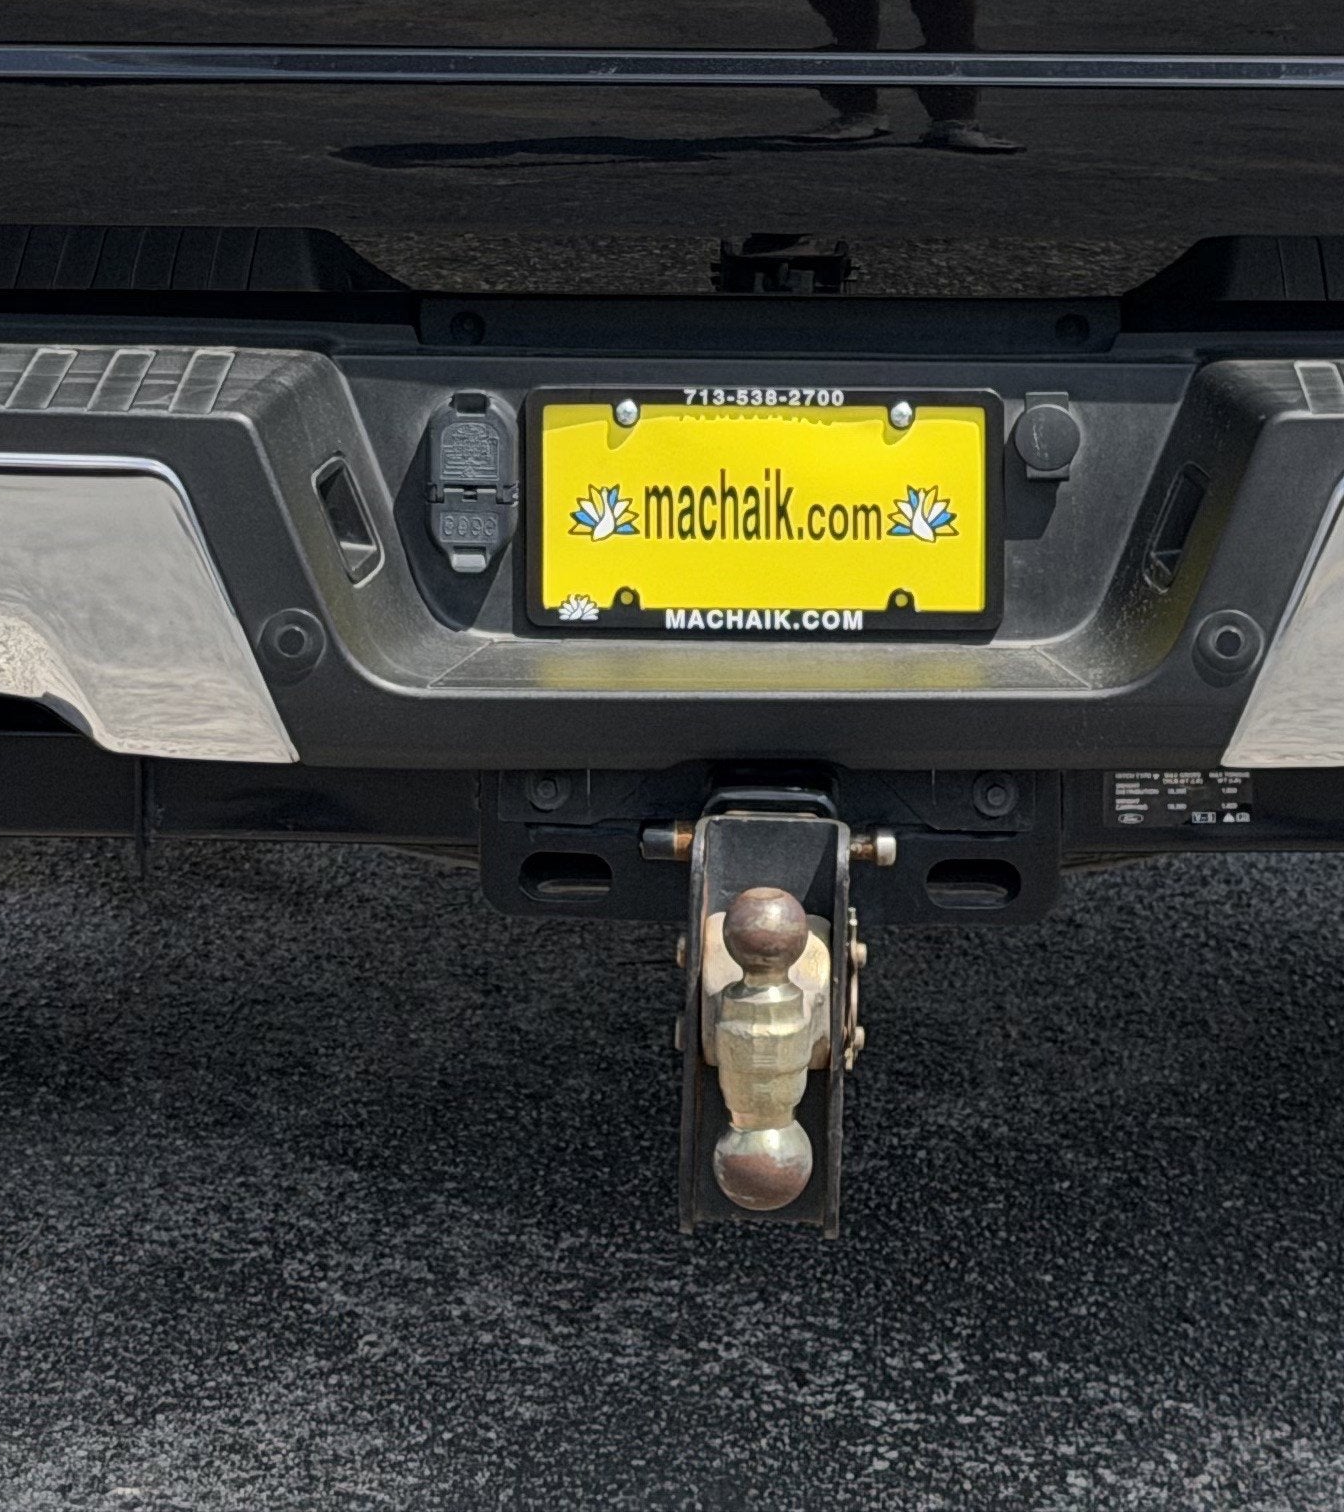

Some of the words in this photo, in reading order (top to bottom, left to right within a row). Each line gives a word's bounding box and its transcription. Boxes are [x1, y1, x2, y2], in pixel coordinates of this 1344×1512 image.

[684, 389, 845, 406] 713-538-2700
[644, 467, 883, 541] machaik.com
[664, 608, 863, 630] MACHAIK.COM
